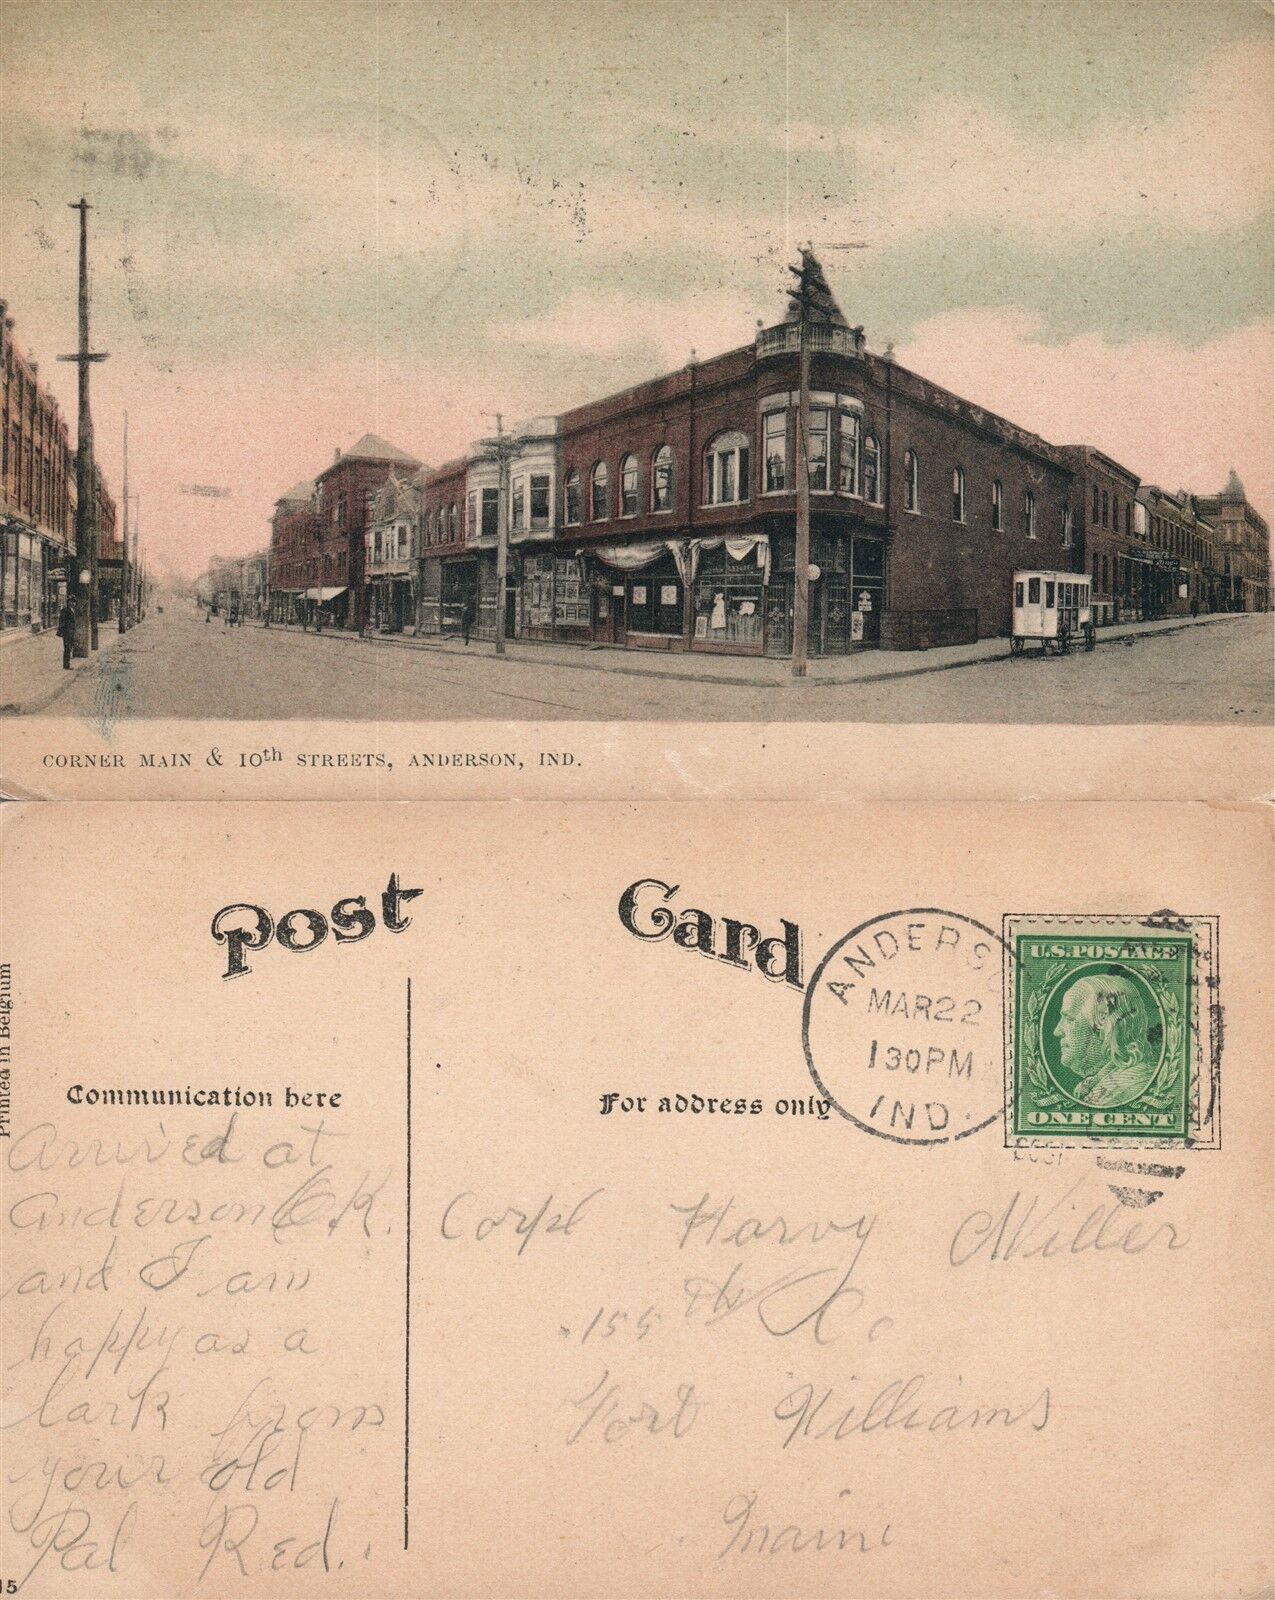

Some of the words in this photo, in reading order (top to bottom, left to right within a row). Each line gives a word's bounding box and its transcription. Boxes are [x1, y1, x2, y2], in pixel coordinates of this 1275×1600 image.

[42, 753, 127, 769] CORNER
[139, 753, 193, 768] MAIN
[205, 746, 225, 768] &
[239, 747, 284, 768] 10th
[296, 753, 394, 771] STREETS,
[408, 753, 524, 770] ANDERSON,
[538, 753, 583, 767] IND.
[618, 878, 806, 994] Card
[66, 1085, 273, 1107] Communication
[286, 1087, 342, 1108] here
[599, 1092, 648, 1115] For
[658, 1094, 763, 1115] address
[775, 1096, 831, 1120] only
[1026, 1111, 1090, 1127] ONE
[1093, 1112, 1178, 1128] CENT
[263, 1120, 346, 1168] at
[3, 1236, 118, 1294] and
[139, 1234, 212, 1291] I
[7, 1301, 184, 1380] happy
[194, 1331, 251, 1355] as
[283, 1327, 322, 1355] a
[2, 1354, 180, 1431] lark
[18, 1500, 138, 1593] Pal
